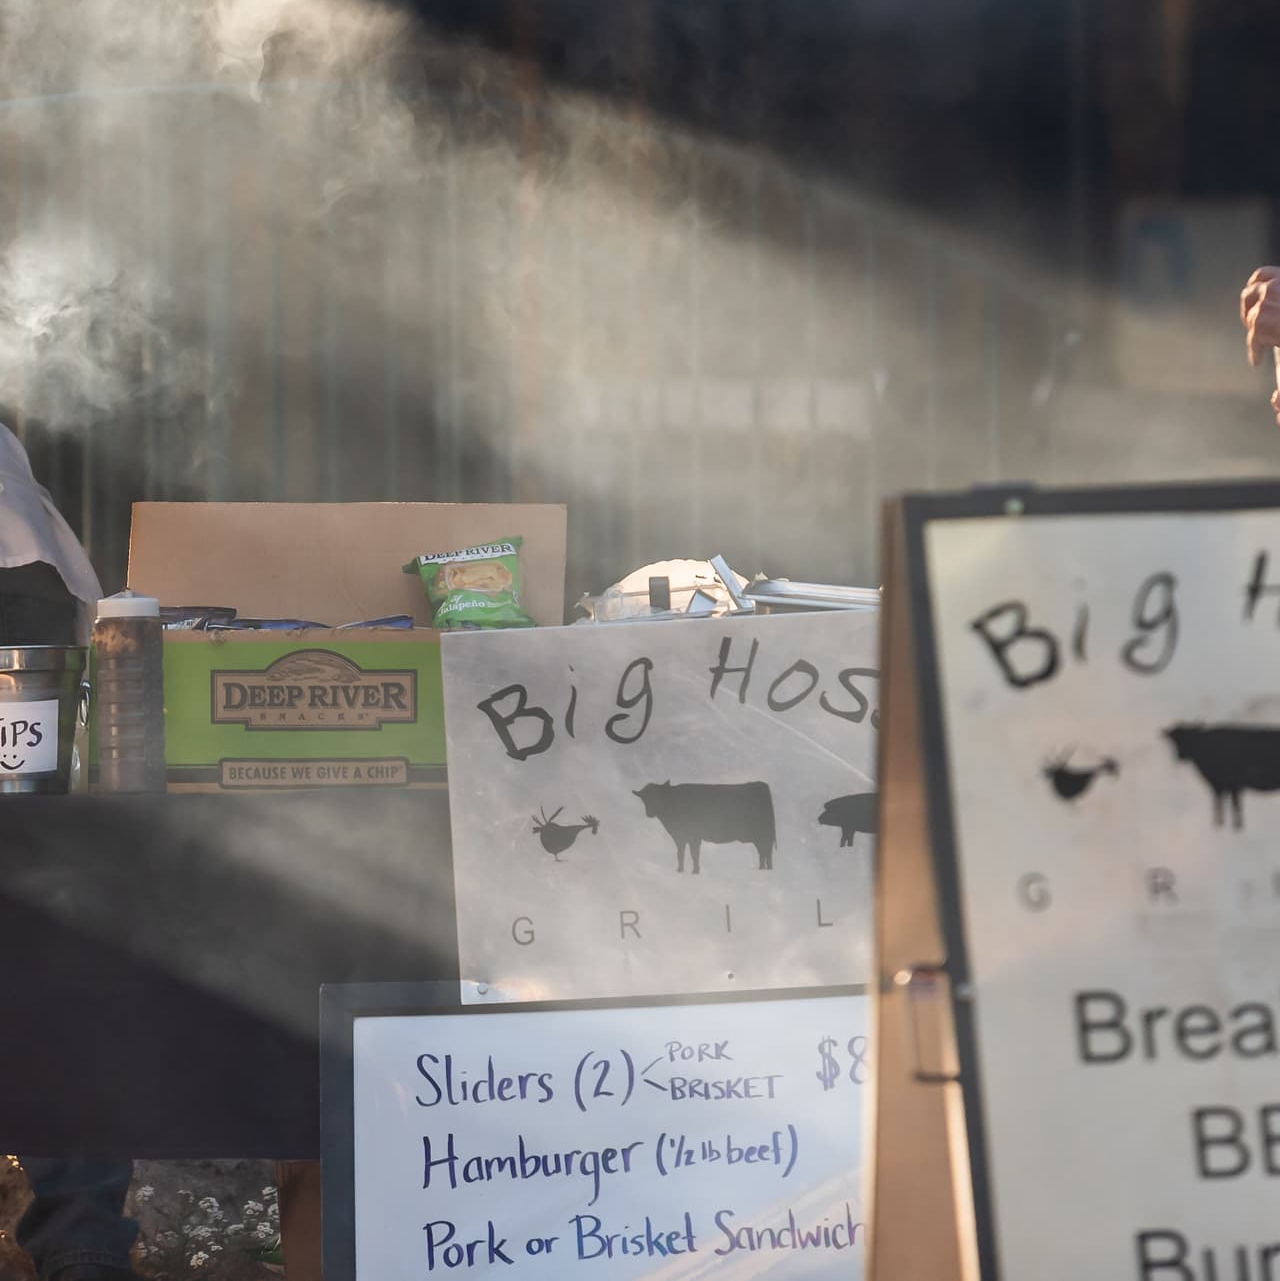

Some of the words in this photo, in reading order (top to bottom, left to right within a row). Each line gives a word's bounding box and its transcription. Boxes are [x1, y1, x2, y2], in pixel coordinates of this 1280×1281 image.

[465, 544, 513, 556] RIVER
[971, 571, 1179, 689] Big
[223, 682, 303, 710] DEEP
[308, 682, 406, 711] RIVER
[477, 656, 654, 761] Big
[229, 767, 287, 780] BECAUSE
[291, 767, 312, 780] WE
[316, 766, 349, 779] GIVE
[353, 766, 363, 779] A
[367, 765, 398, 779] CHIP
[665, 1040, 732, 1062] PORK
[816, 1035, 869, 1091] $8
[416, 1054, 554, 1107] Sliders
[574, 1049, 635, 1112] (2)
[670, 1075, 782, 1100] BRISKET
[422, 1133, 644, 1206] Hamburger
[423, 1220, 514, 1270] Pork
[526, 1236, 557, 1255] or
[569, 1212, 697, 1259] Brisket
